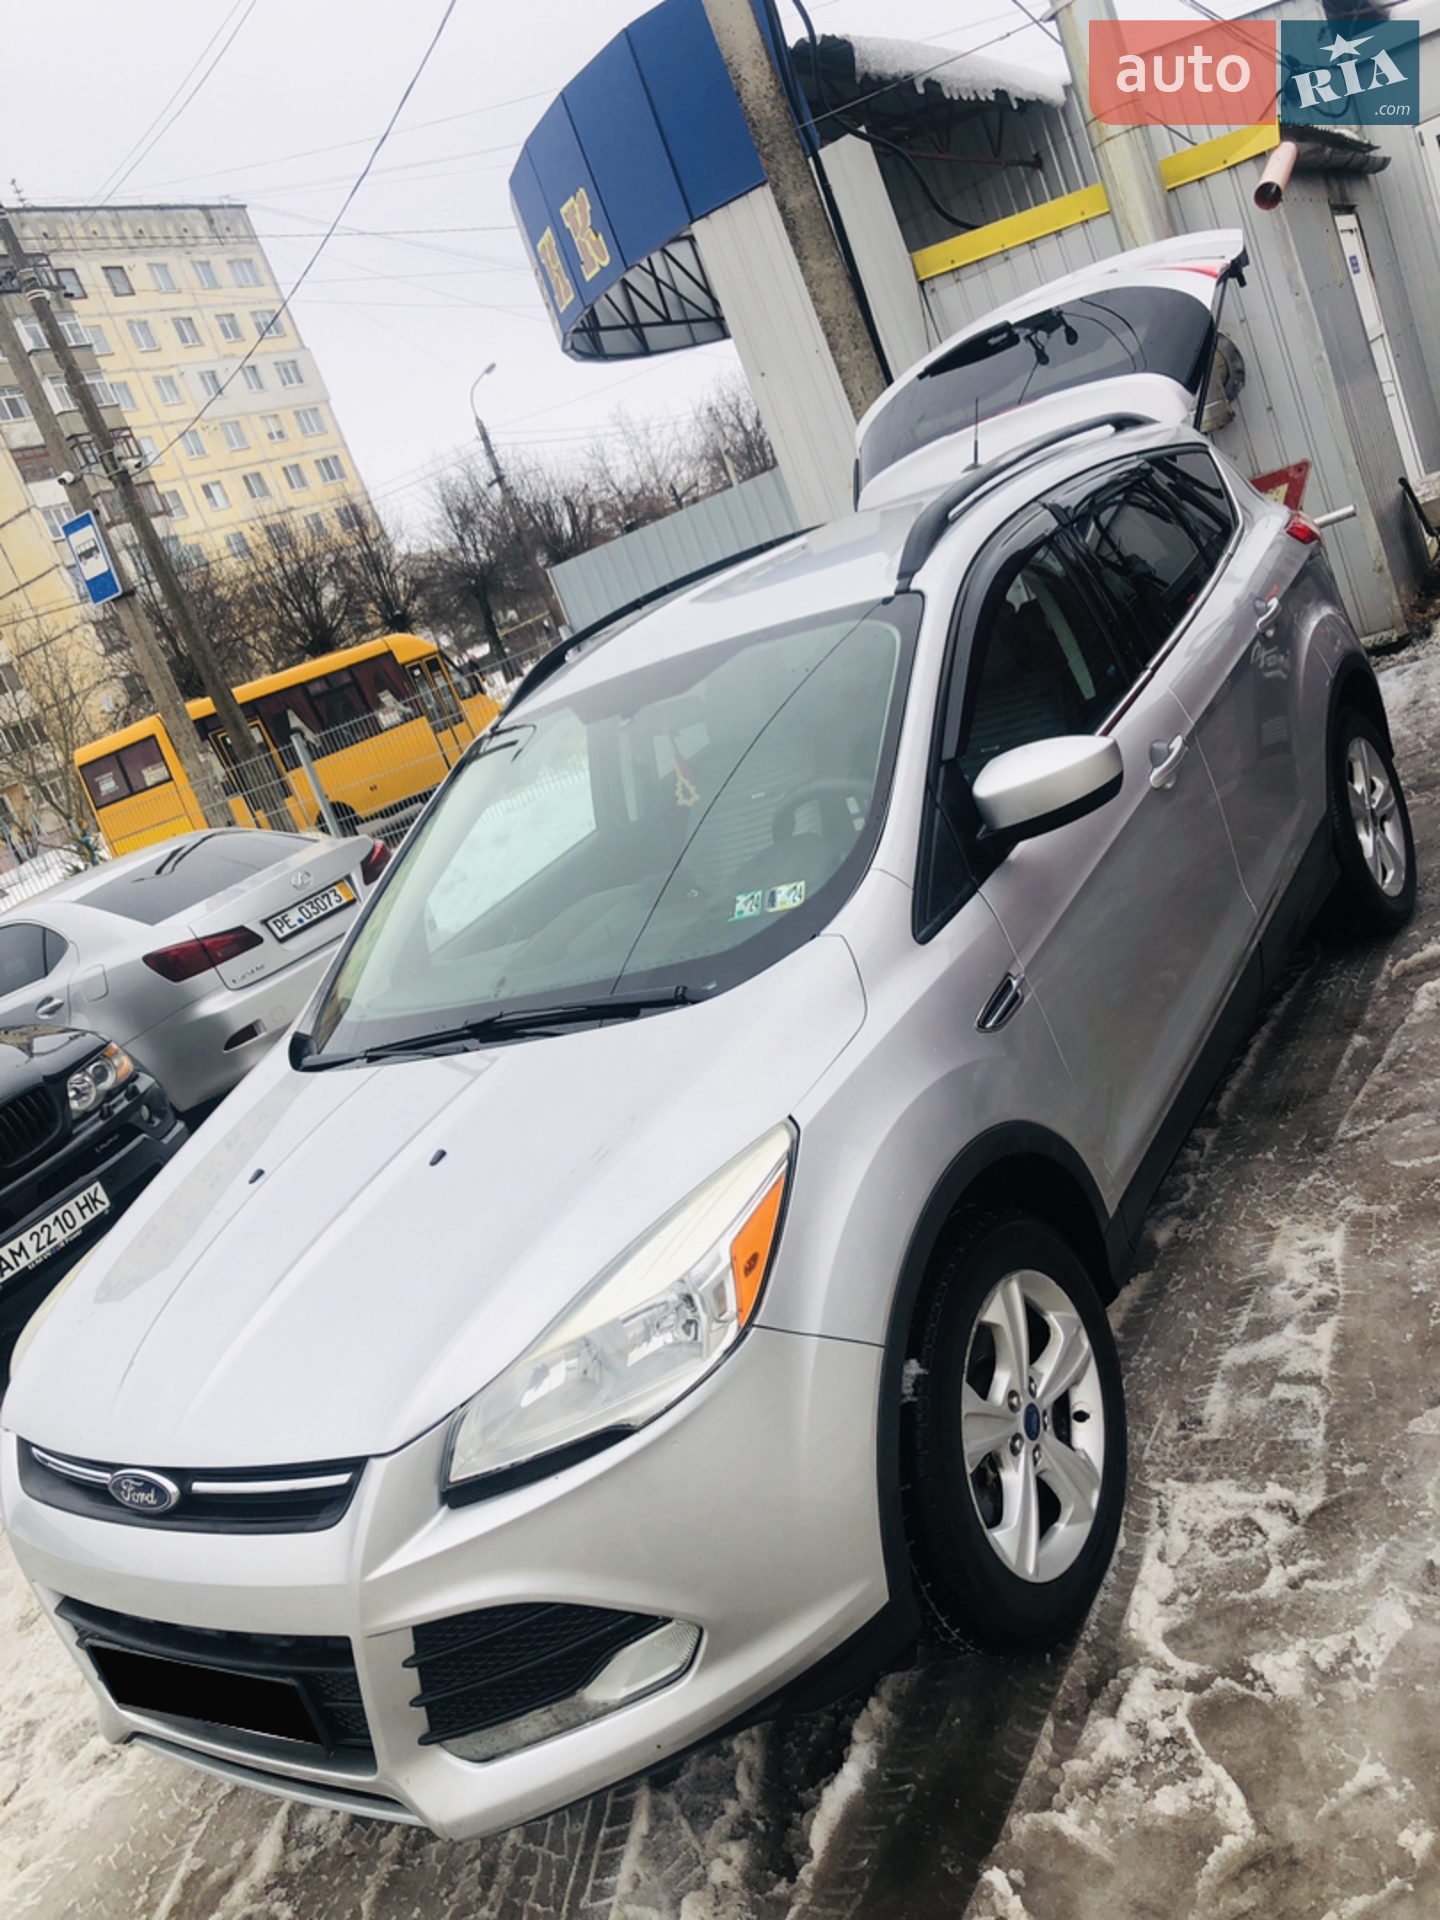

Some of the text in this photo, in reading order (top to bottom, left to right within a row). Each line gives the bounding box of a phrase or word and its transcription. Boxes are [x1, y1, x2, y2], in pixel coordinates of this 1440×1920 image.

[272, 888, 343, 934] PE 03073
[29, 1208, 77, 1254] 2210
[74, 1186, 107, 1221] HK
[120, 1478, 158, 1506] Ford
